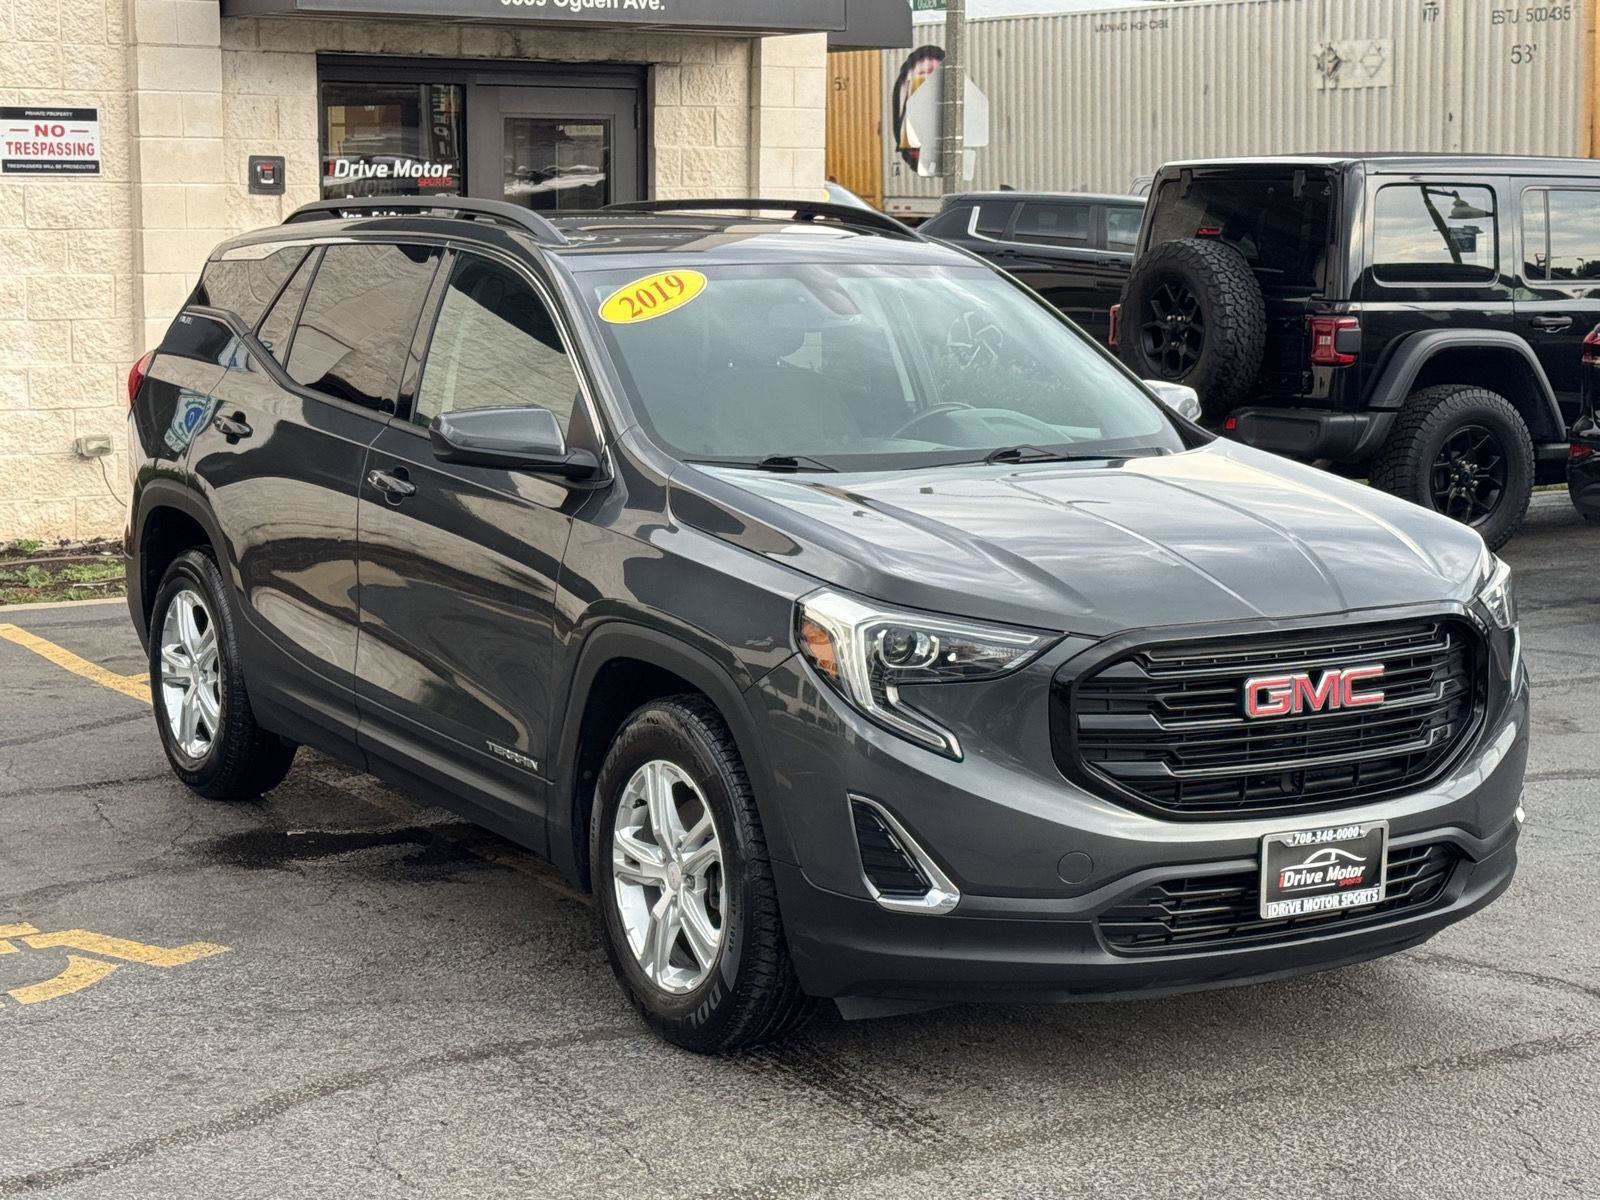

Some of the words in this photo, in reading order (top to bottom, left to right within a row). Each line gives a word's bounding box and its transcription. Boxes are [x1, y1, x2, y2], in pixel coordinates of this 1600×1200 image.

[34, 124, 66, 138] NO
[5, 141, 95, 157] TRESPASSING
[393, 159, 453, 178] Motor
[416, 176, 453, 187] SPORTS
[618, 274, 685, 319] 2019
[1243, 663, 1386, 720] GMC
[1294, 826, 1359, 845] 708-348-0000
[1278, 868, 1324, 889] iDrive
[1326, 864, 1366, 882] Motor
[1303, 896, 1340, 913] MOTOR
[1341, 889, 1379, 908] SPORTS
